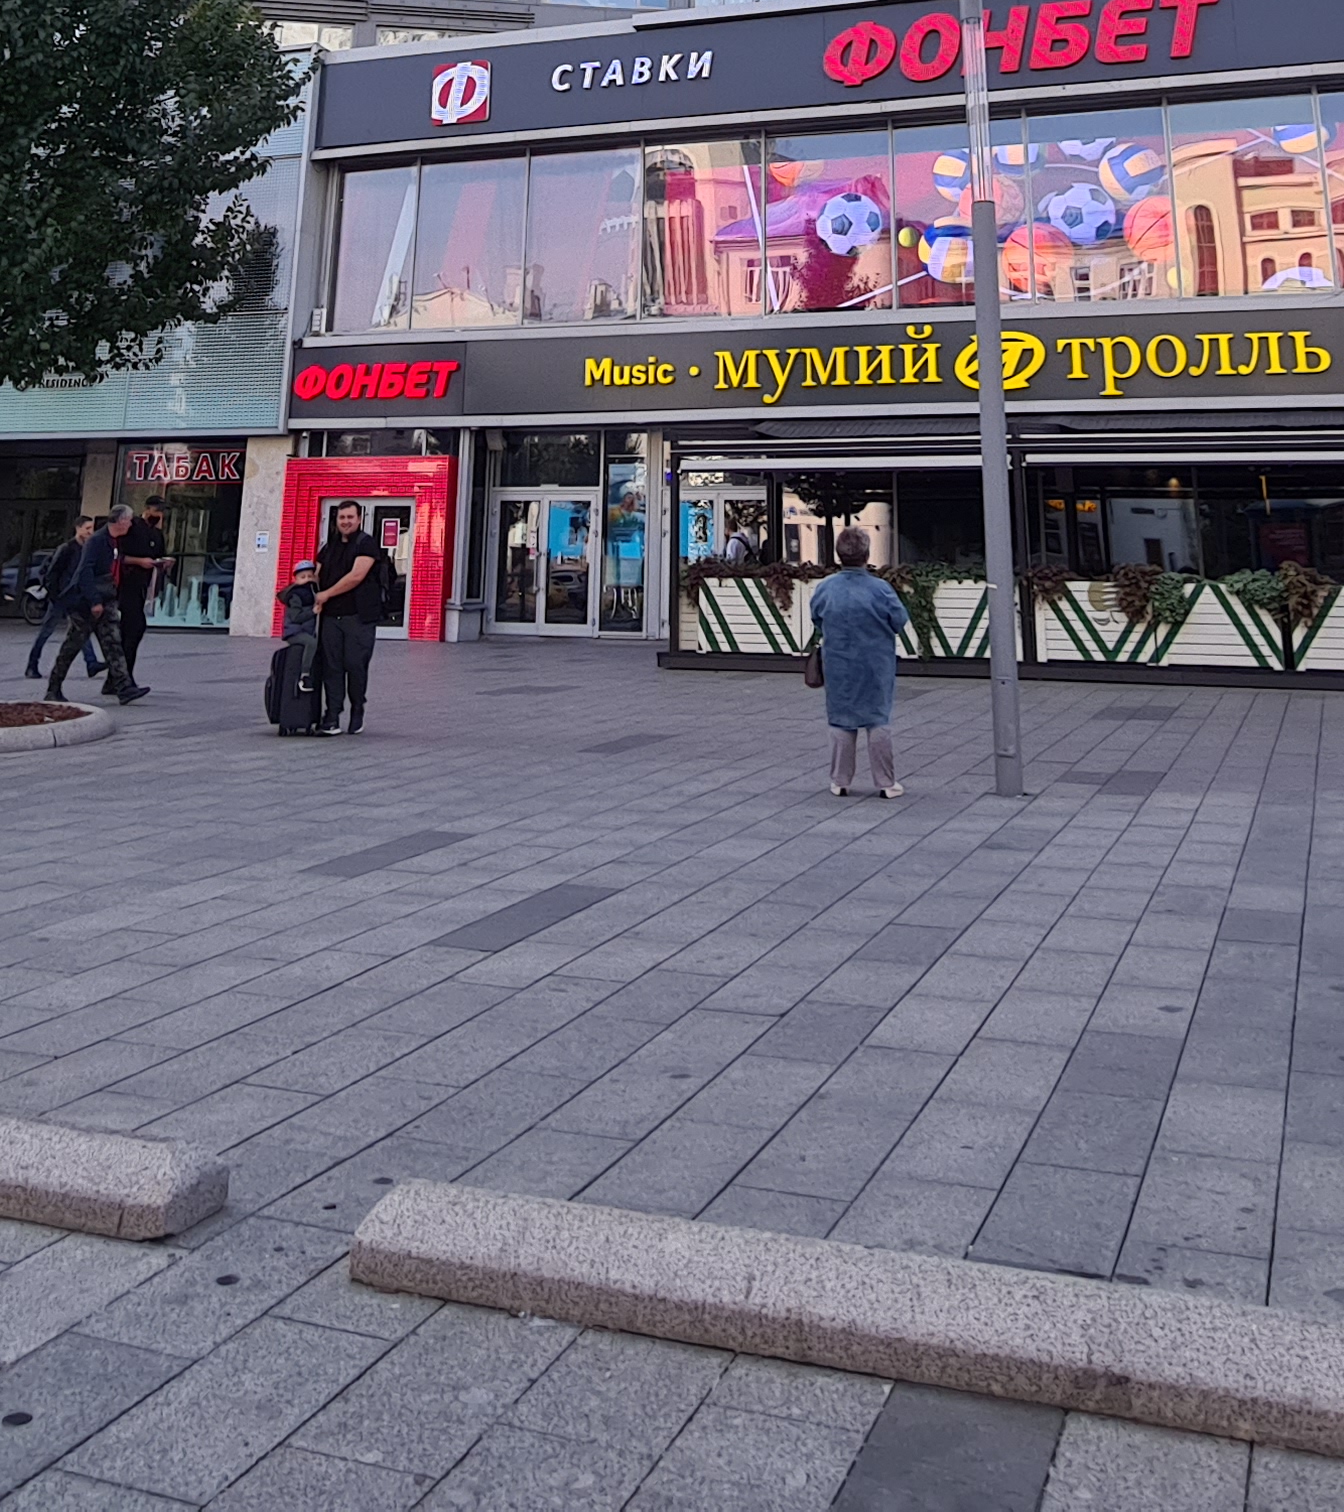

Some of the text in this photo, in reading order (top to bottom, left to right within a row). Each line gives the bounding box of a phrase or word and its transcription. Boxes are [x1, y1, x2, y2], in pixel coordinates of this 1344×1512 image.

[551, 50, 714, 92] СТАВКИ
[294, 360, 459, 401] ФОНБЕТ
[584, 355, 676, 387] Music
[713, 324, 943, 404] мумий
[1056, 330, 1333, 397] тролль
[132, 452, 242, 481] ТАБАК
